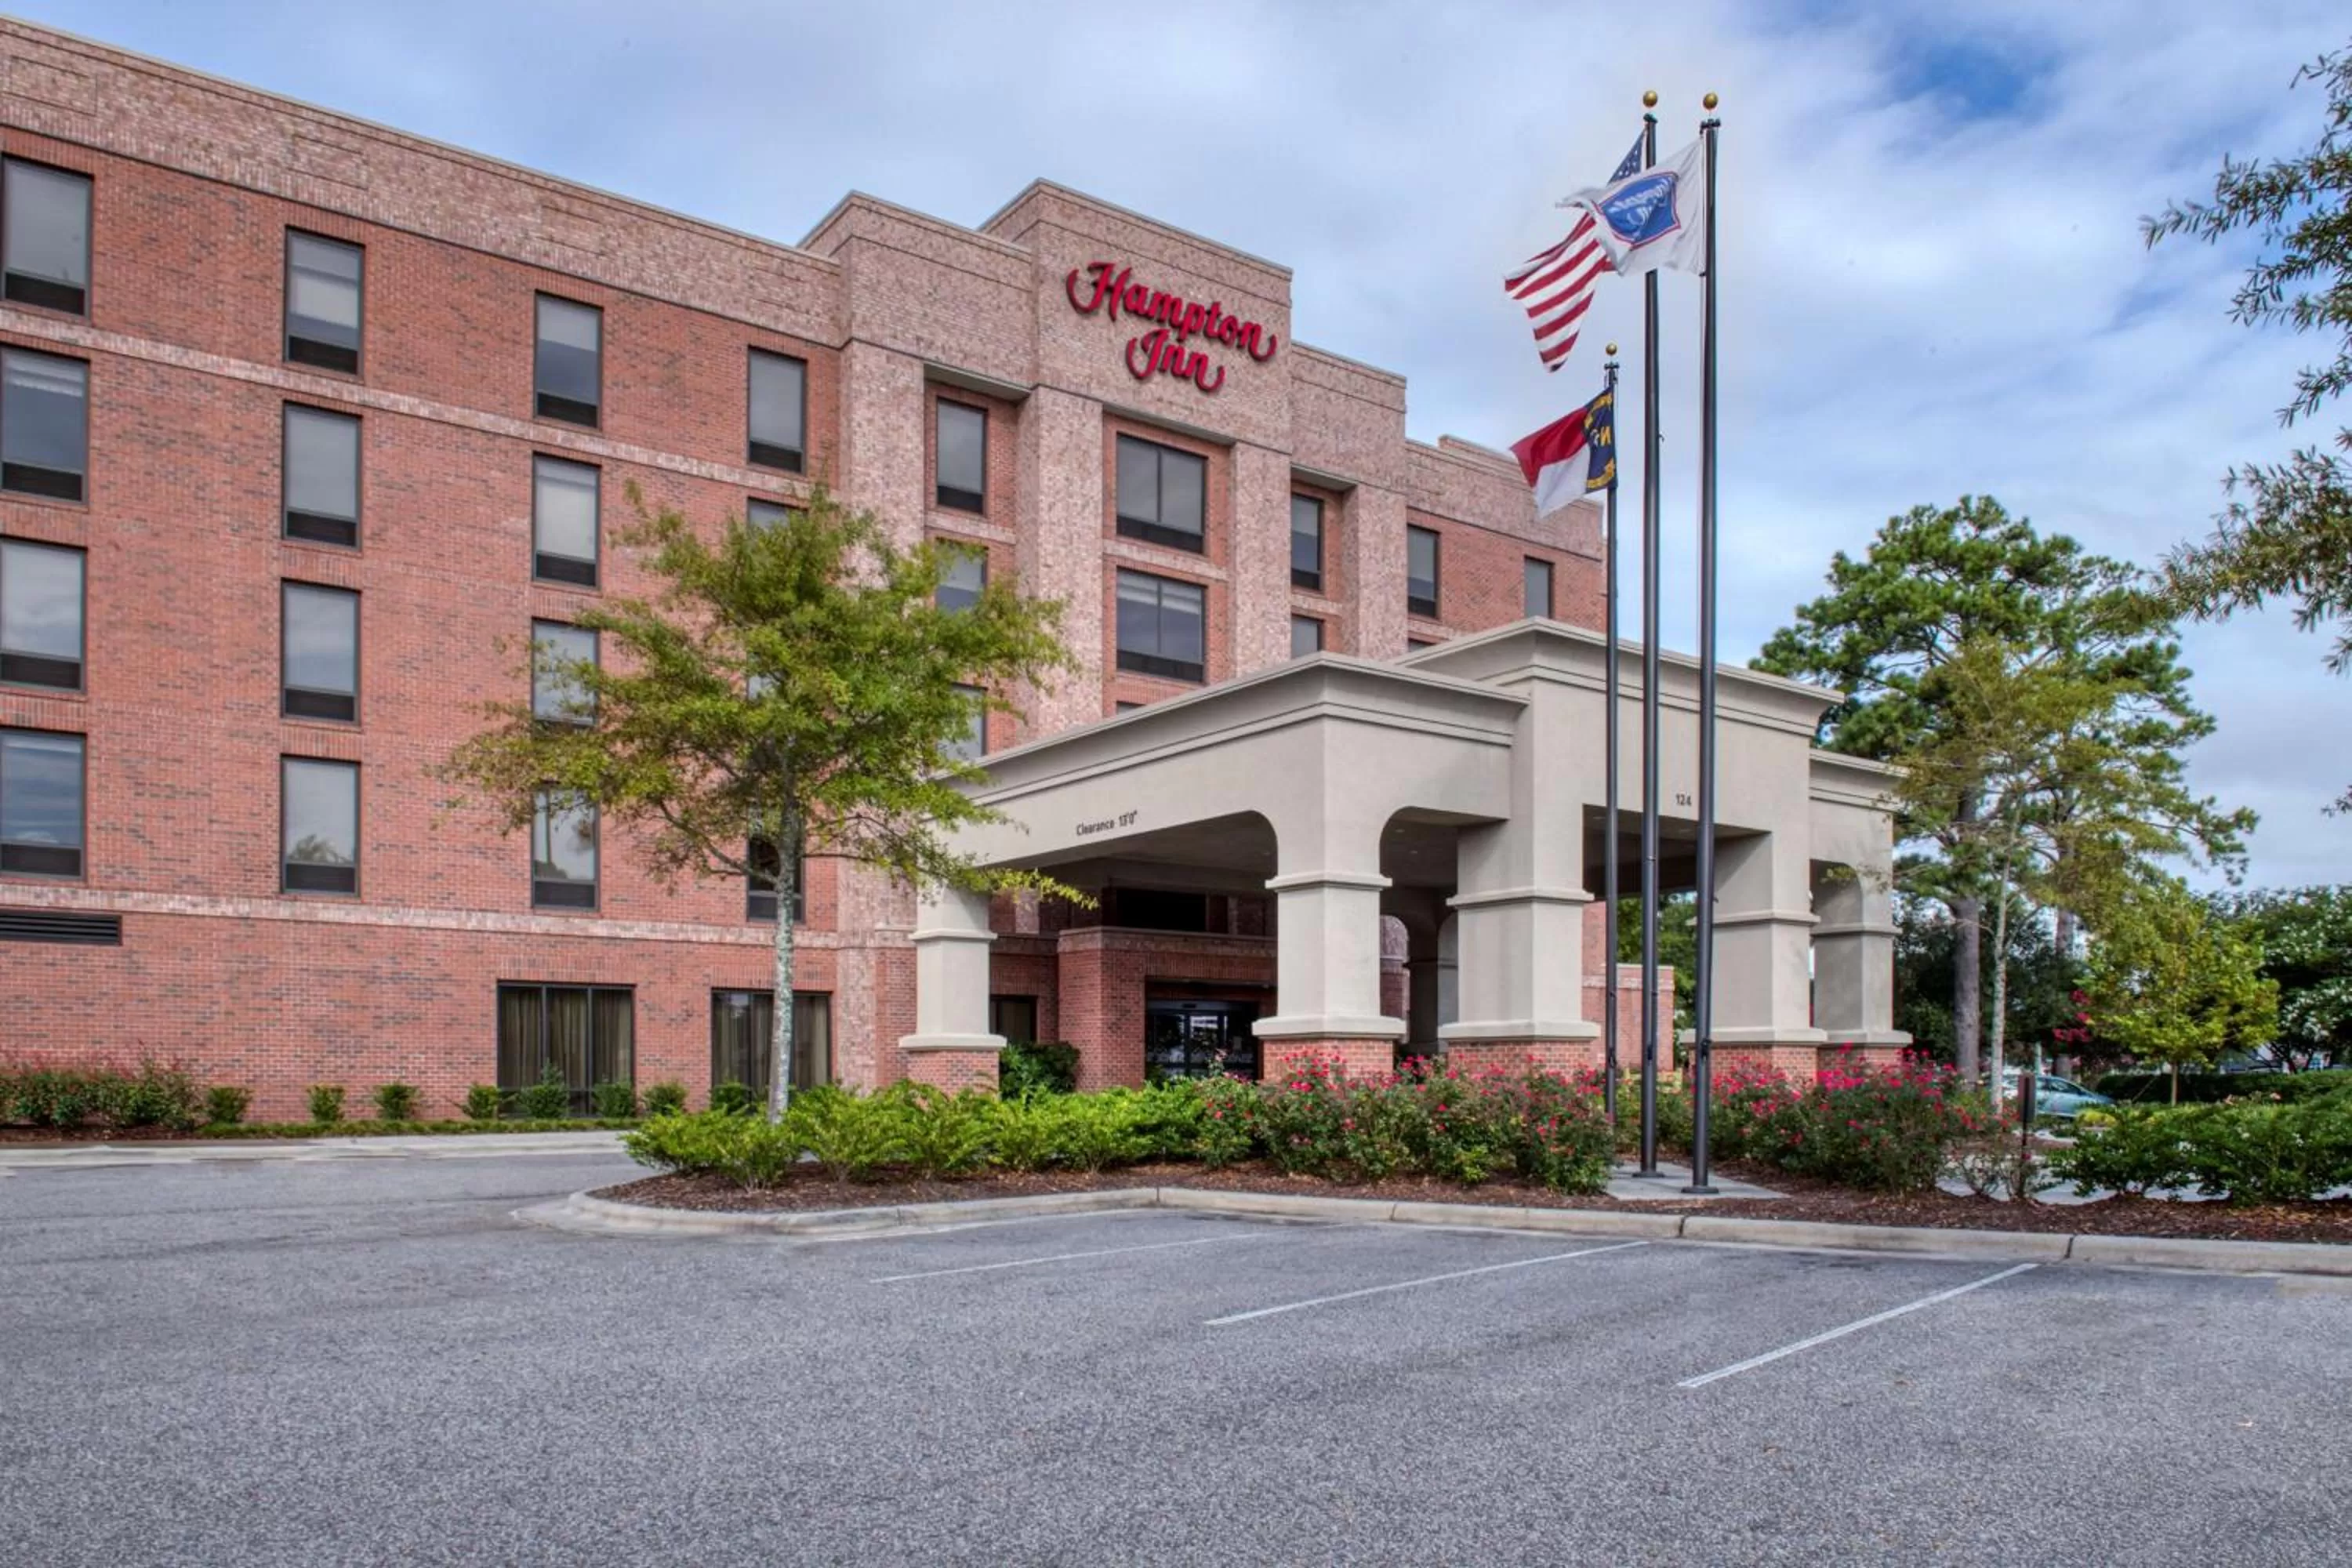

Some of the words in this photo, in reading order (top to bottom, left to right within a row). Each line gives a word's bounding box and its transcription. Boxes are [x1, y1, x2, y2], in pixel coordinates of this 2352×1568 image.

[1066, 261, 1277, 362] Hampton
[1127, 328, 1225, 391] Inn
[1676, 793, 1691, 807] 124
[1076, 819, 1114, 836] Clearance
